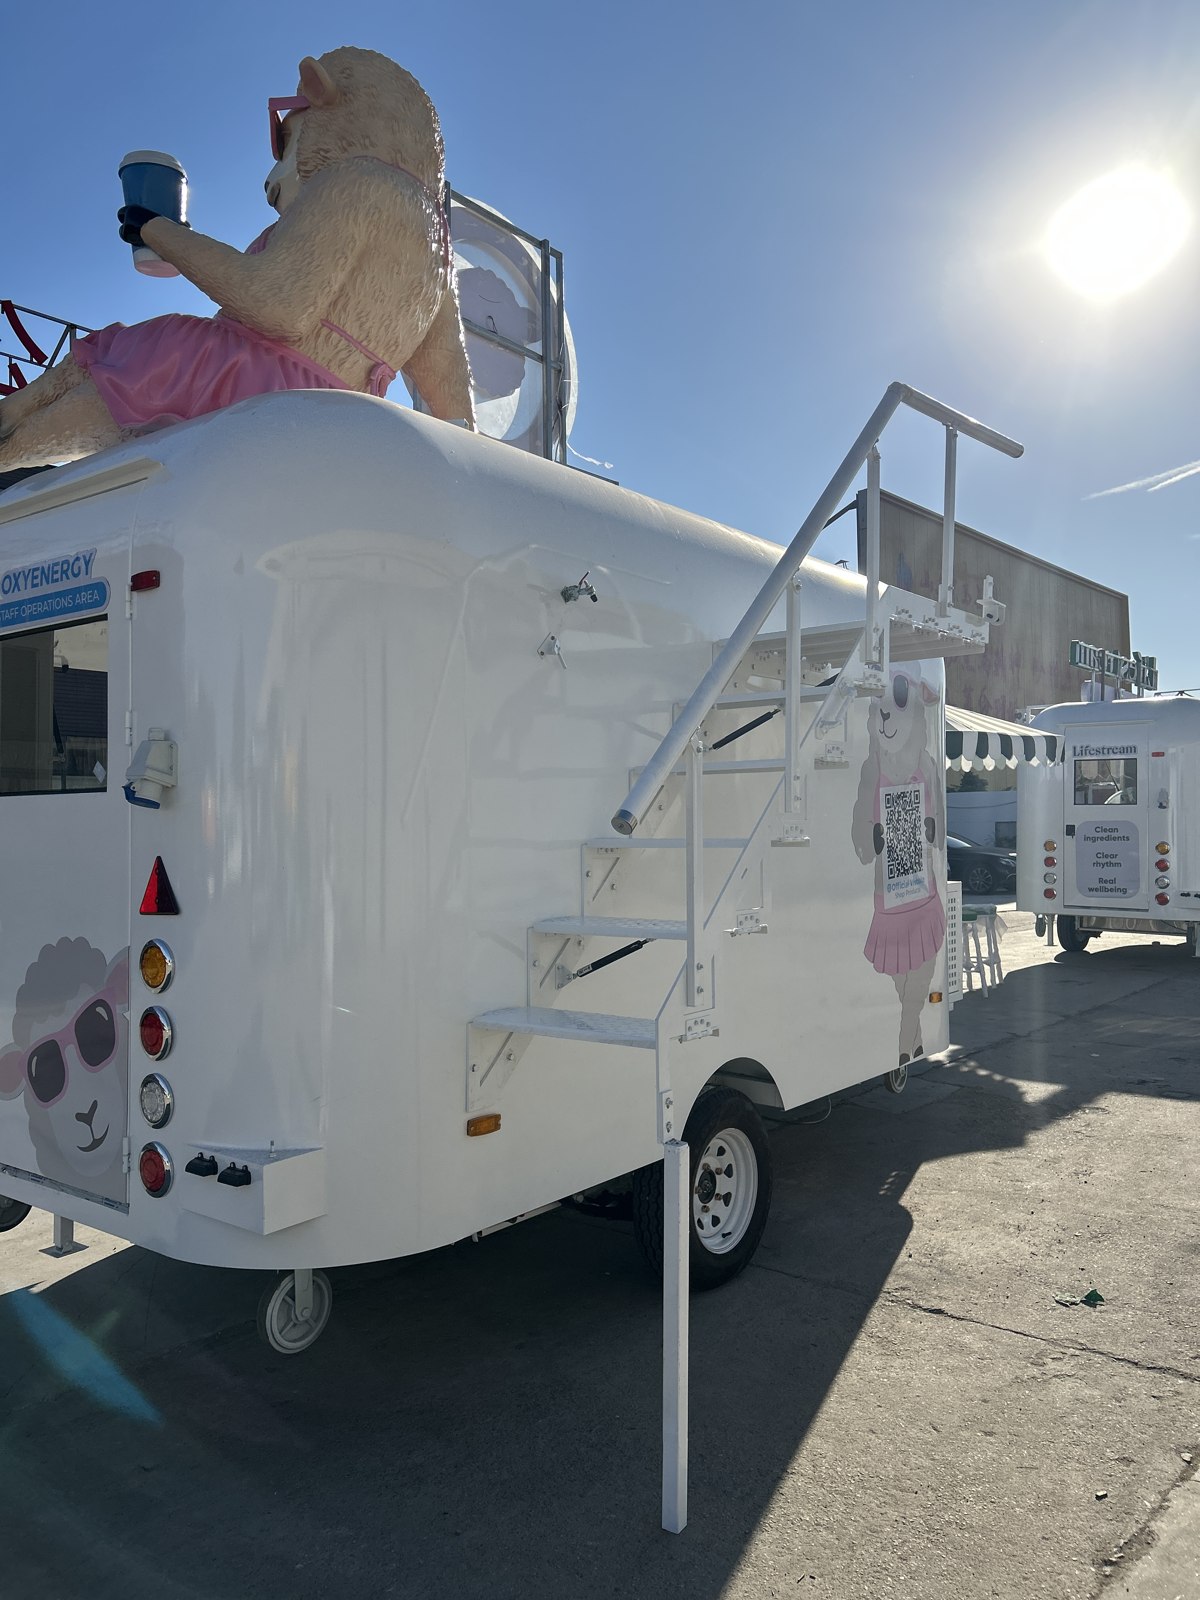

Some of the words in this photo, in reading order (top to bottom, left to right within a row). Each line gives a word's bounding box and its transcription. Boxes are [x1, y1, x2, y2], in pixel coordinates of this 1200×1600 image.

[1, 552, 93, 595] OXYENERGY
[0, 606, 19, 621] TAFF
[20, 594, 74, 618] OPERATIONS
[75, 589, 100, 605] AREA
[1072, 744, 1138, 757] Lifestream
[1094, 825, 1119, 834] Clean
[1083, 834, 1130, 843] ingredients
[1092, 860, 1122, 869] rhythm
[1098, 877, 1117, 885] Real
[1088, 885, 1128, 895] wellbeing
